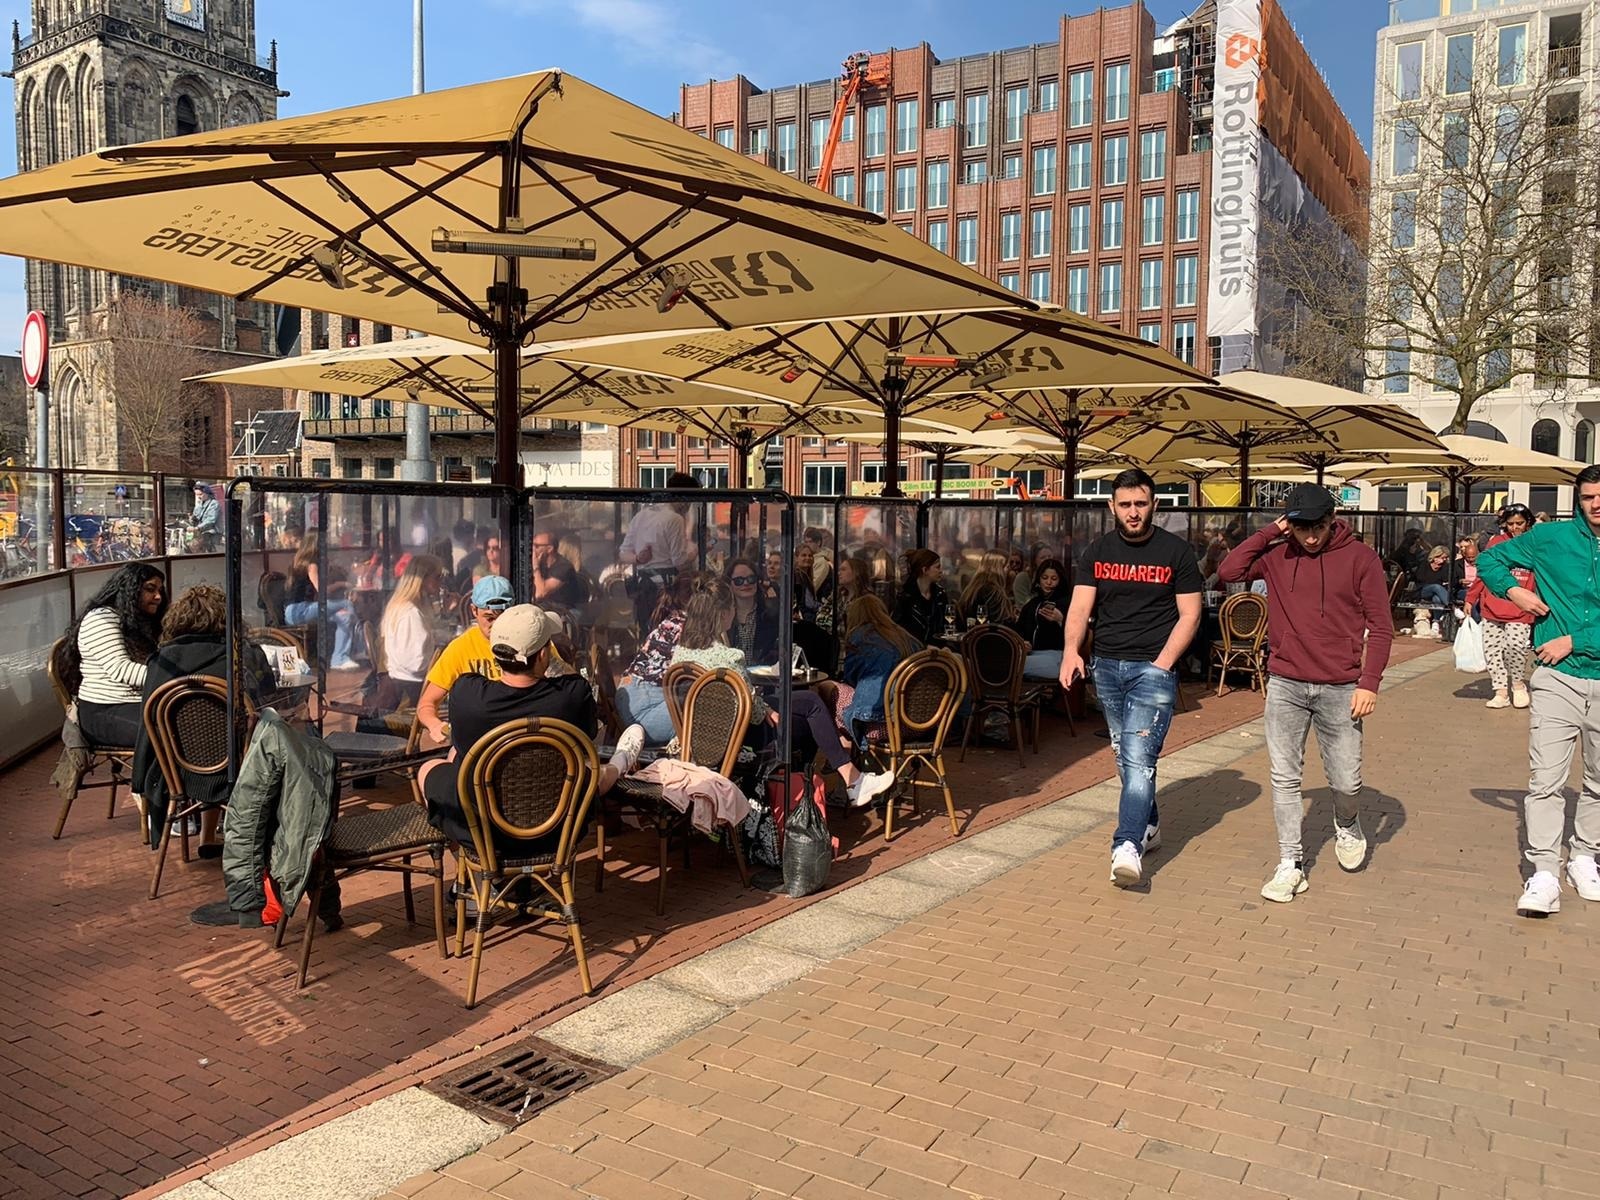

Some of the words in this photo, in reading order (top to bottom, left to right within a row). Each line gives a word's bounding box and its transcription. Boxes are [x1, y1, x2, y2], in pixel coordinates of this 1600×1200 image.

[1214, 80, 1255, 298] Rottinghuis
[569, 461, 611, 477] FIDES
[921, 480, 955, 490] ELERIC
[956, 480, 977, 489] BOOM
[1094, 561, 1172, 584] DSQUARED2
